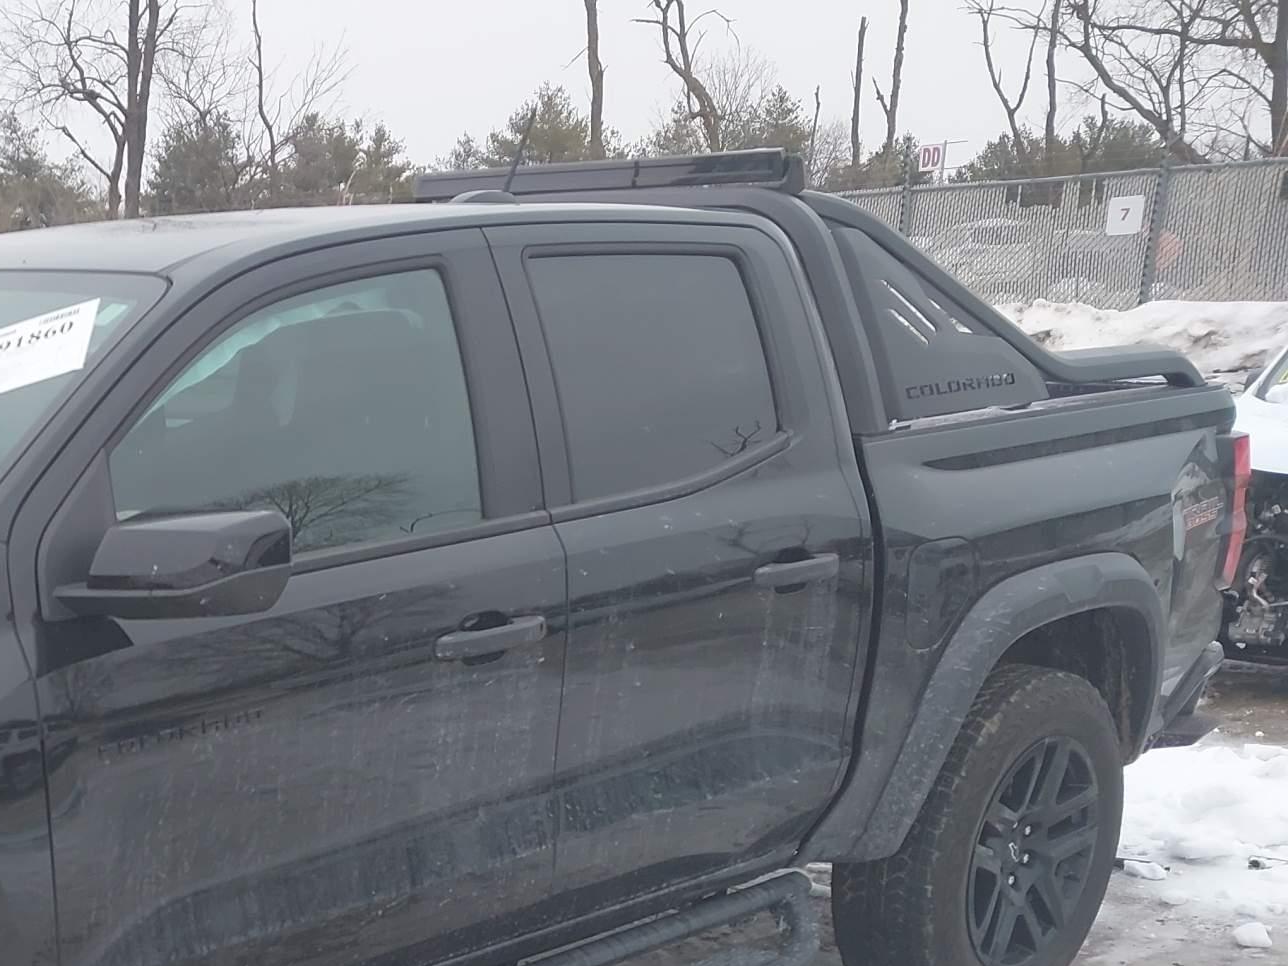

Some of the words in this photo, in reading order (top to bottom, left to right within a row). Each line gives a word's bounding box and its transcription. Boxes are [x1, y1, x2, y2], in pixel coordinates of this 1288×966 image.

[922, 146, 941, 168] DD
[1120, 207, 1131, 221] 7
[905, 372, 1015, 399] COLORADO
